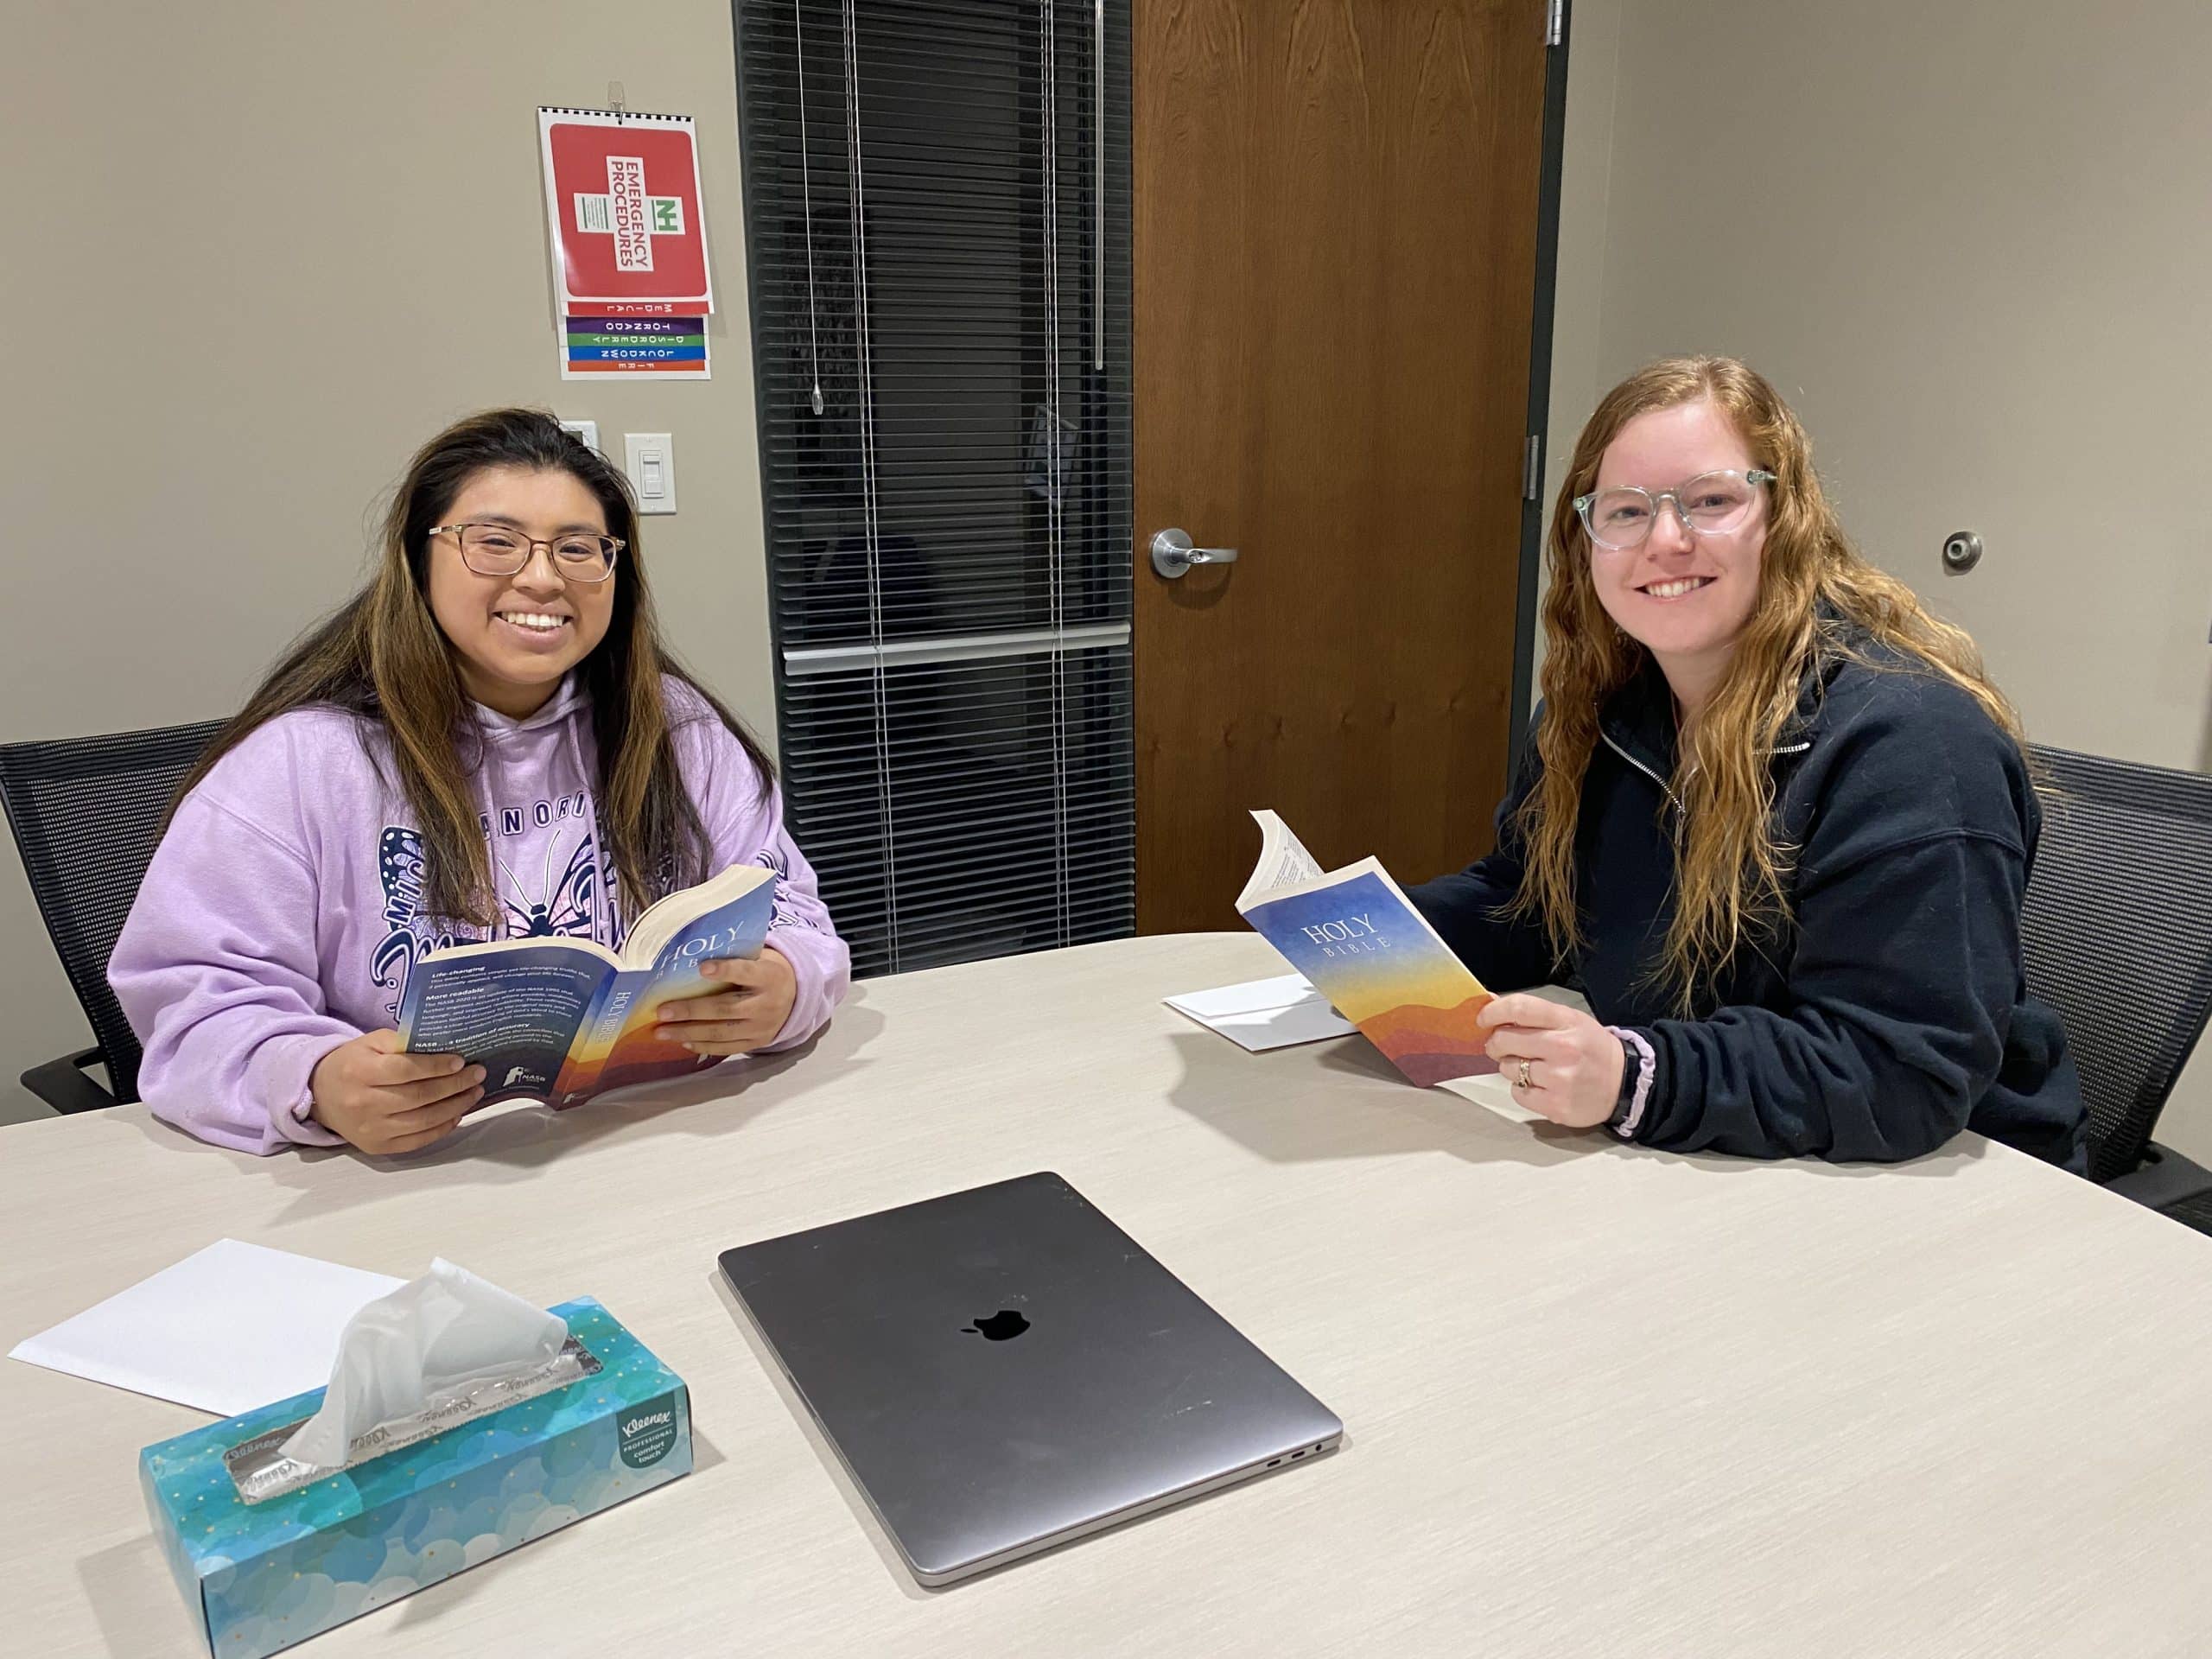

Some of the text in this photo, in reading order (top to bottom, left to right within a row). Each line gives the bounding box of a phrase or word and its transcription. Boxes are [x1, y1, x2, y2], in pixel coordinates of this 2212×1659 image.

[611, 161, 633, 267] PROCEDURES
[626, 162, 648, 267] EMERGENCY
[656, 200, 678, 232] NH
[607, 304, 673, 313] MEDICAL
[606, 322, 671, 331] TORNADO
[593, 335, 684, 344] DISORDERLY
[1300, 913, 1378, 944] HOLY
[660, 920, 744, 969] HOLY
[1323, 937, 1391, 957] BIBLE
[449, 988, 484, 997] readable
[607, 991, 632, 1017] HOLY
[622, 1410, 671, 1438] Kleenex
[623, 1428, 673, 1452] PROFESSIONAL
[633, 1441, 664, 1458] comfort
[639, 1451, 662, 1463] touch
